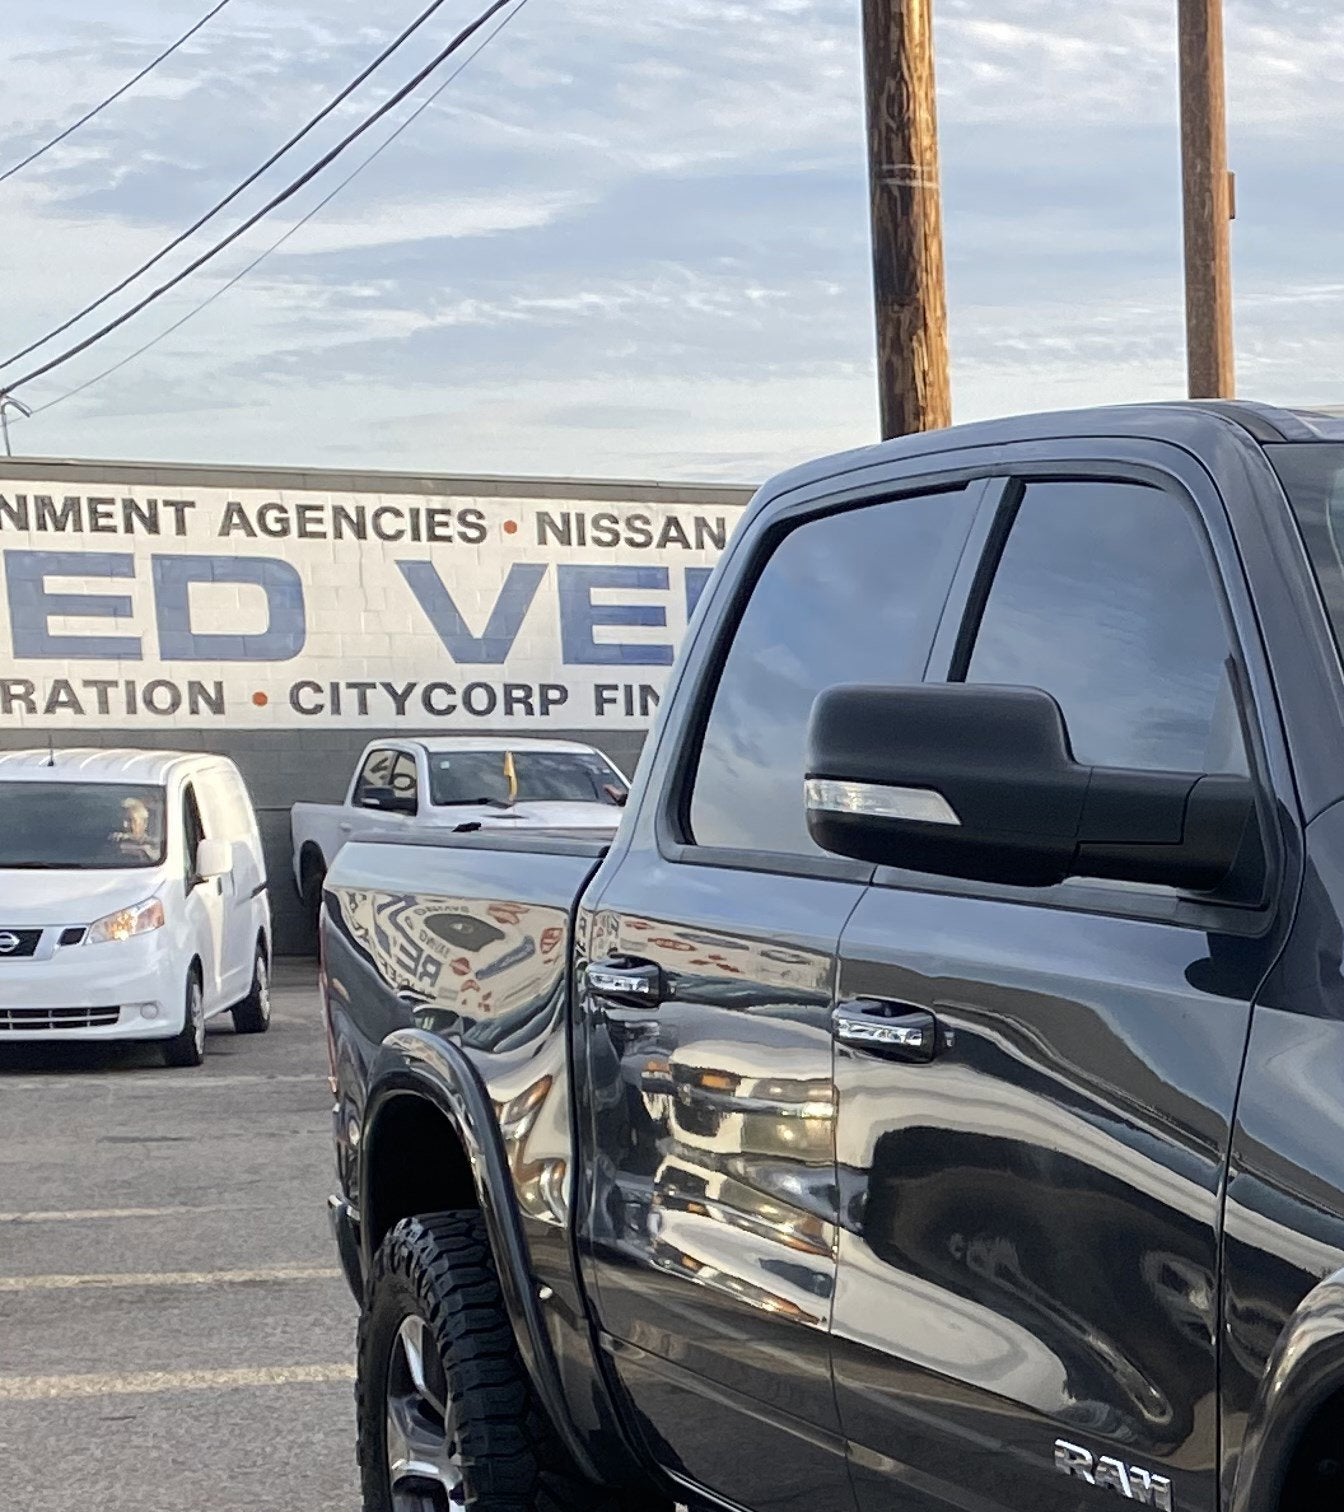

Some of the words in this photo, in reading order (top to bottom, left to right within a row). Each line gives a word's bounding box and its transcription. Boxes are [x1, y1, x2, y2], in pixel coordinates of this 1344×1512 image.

[0, 494, 196, 537] NMENT
[217, 500, 487, 544] AGENCIES
[536, 511, 726, 551] NISSAN
[4, 551, 306, 662] ED
[0, 678, 226, 716] RATION
[289, 681, 569, 717] CITYCORP
